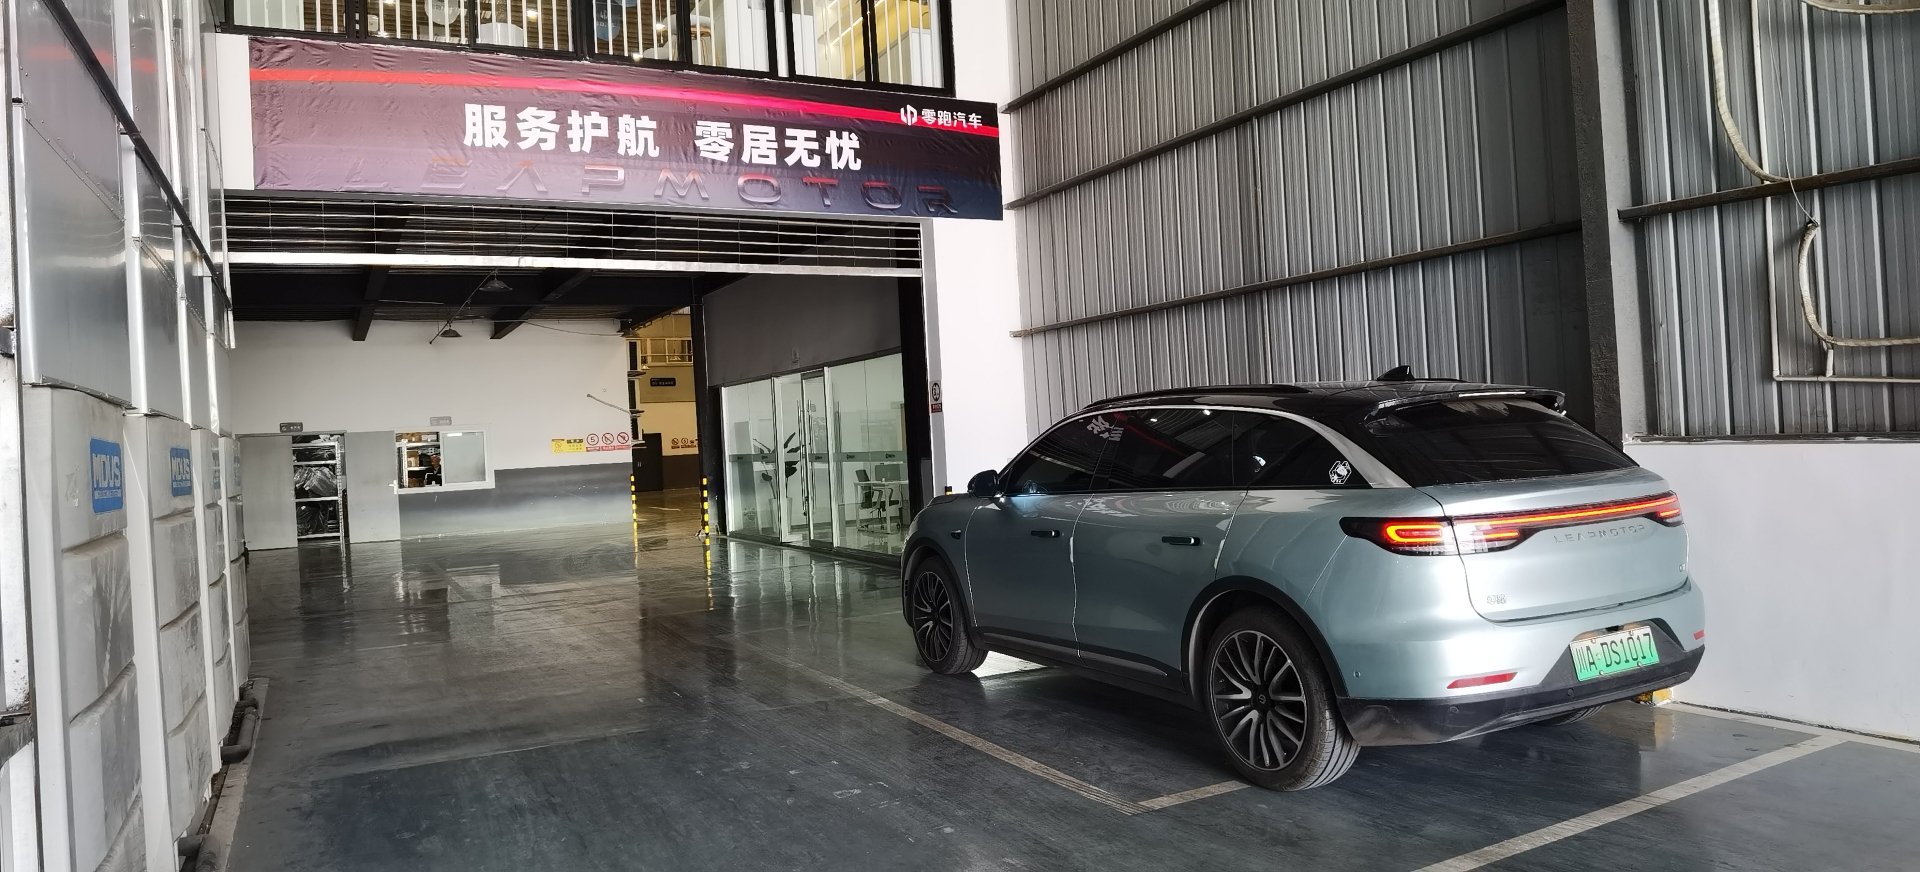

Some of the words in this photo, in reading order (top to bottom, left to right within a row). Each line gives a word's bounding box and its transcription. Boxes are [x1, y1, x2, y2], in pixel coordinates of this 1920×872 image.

[920, 107, 983, 129] 零跑汽车
[463, 102, 660, 159] 服务护航
[694, 120, 862, 171] 零居无忧
[338, 155, 958, 214] LEAPMOTOR
[92, 453, 121, 488] MDUS
[171, 456, 191, 480] MDUS
